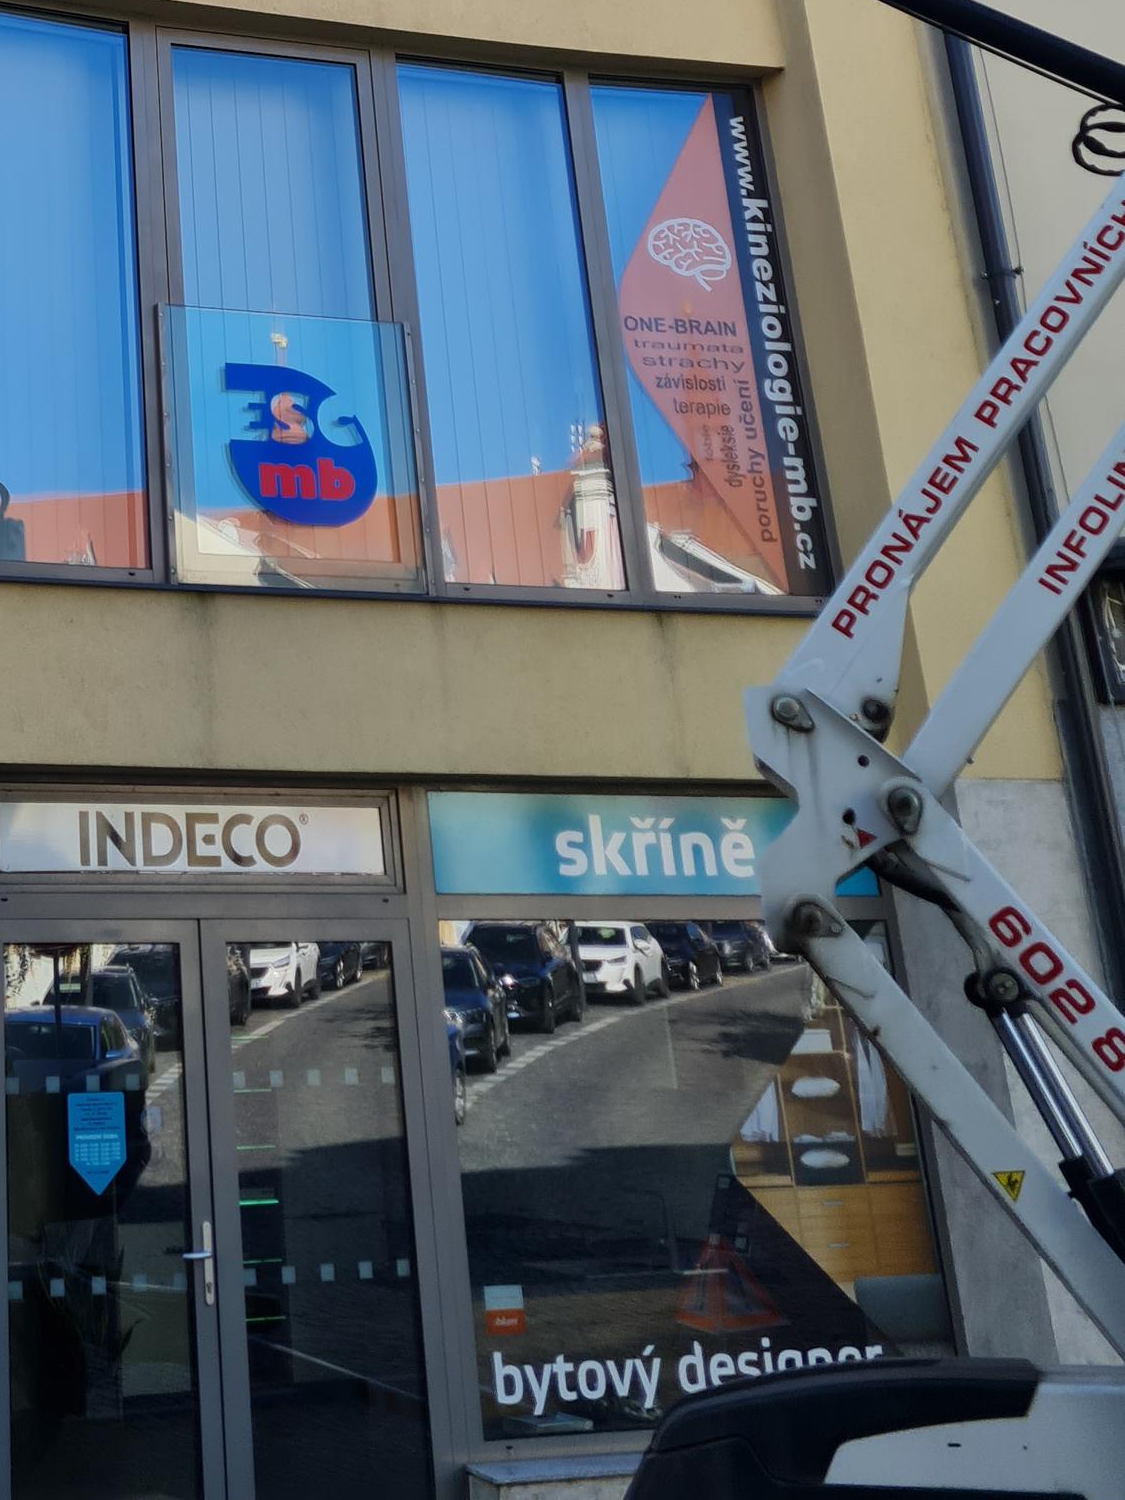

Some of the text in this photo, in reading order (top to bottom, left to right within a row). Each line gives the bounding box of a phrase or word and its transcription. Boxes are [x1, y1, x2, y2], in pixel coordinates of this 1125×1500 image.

[623, 315, 738, 337] ONE-BRAIN
[634, 339, 744, 354] traumata
[729, 115, 817, 571] www.kineziologie-mb.cz
[642, 355, 746, 374] strachy
[655, 374, 727, 393] závislosti
[673, 398, 732, 419] terapie
[258, 456, 356, 501] mb
[733, 380, 777, 543] poruchy učení
[831, 436, 980, 639] PRONÁJEM
[555, 814, 755, 877] skříně
[988, 905, 1096, 1025] 602
[492, 1343, 661, 1416] bytový
